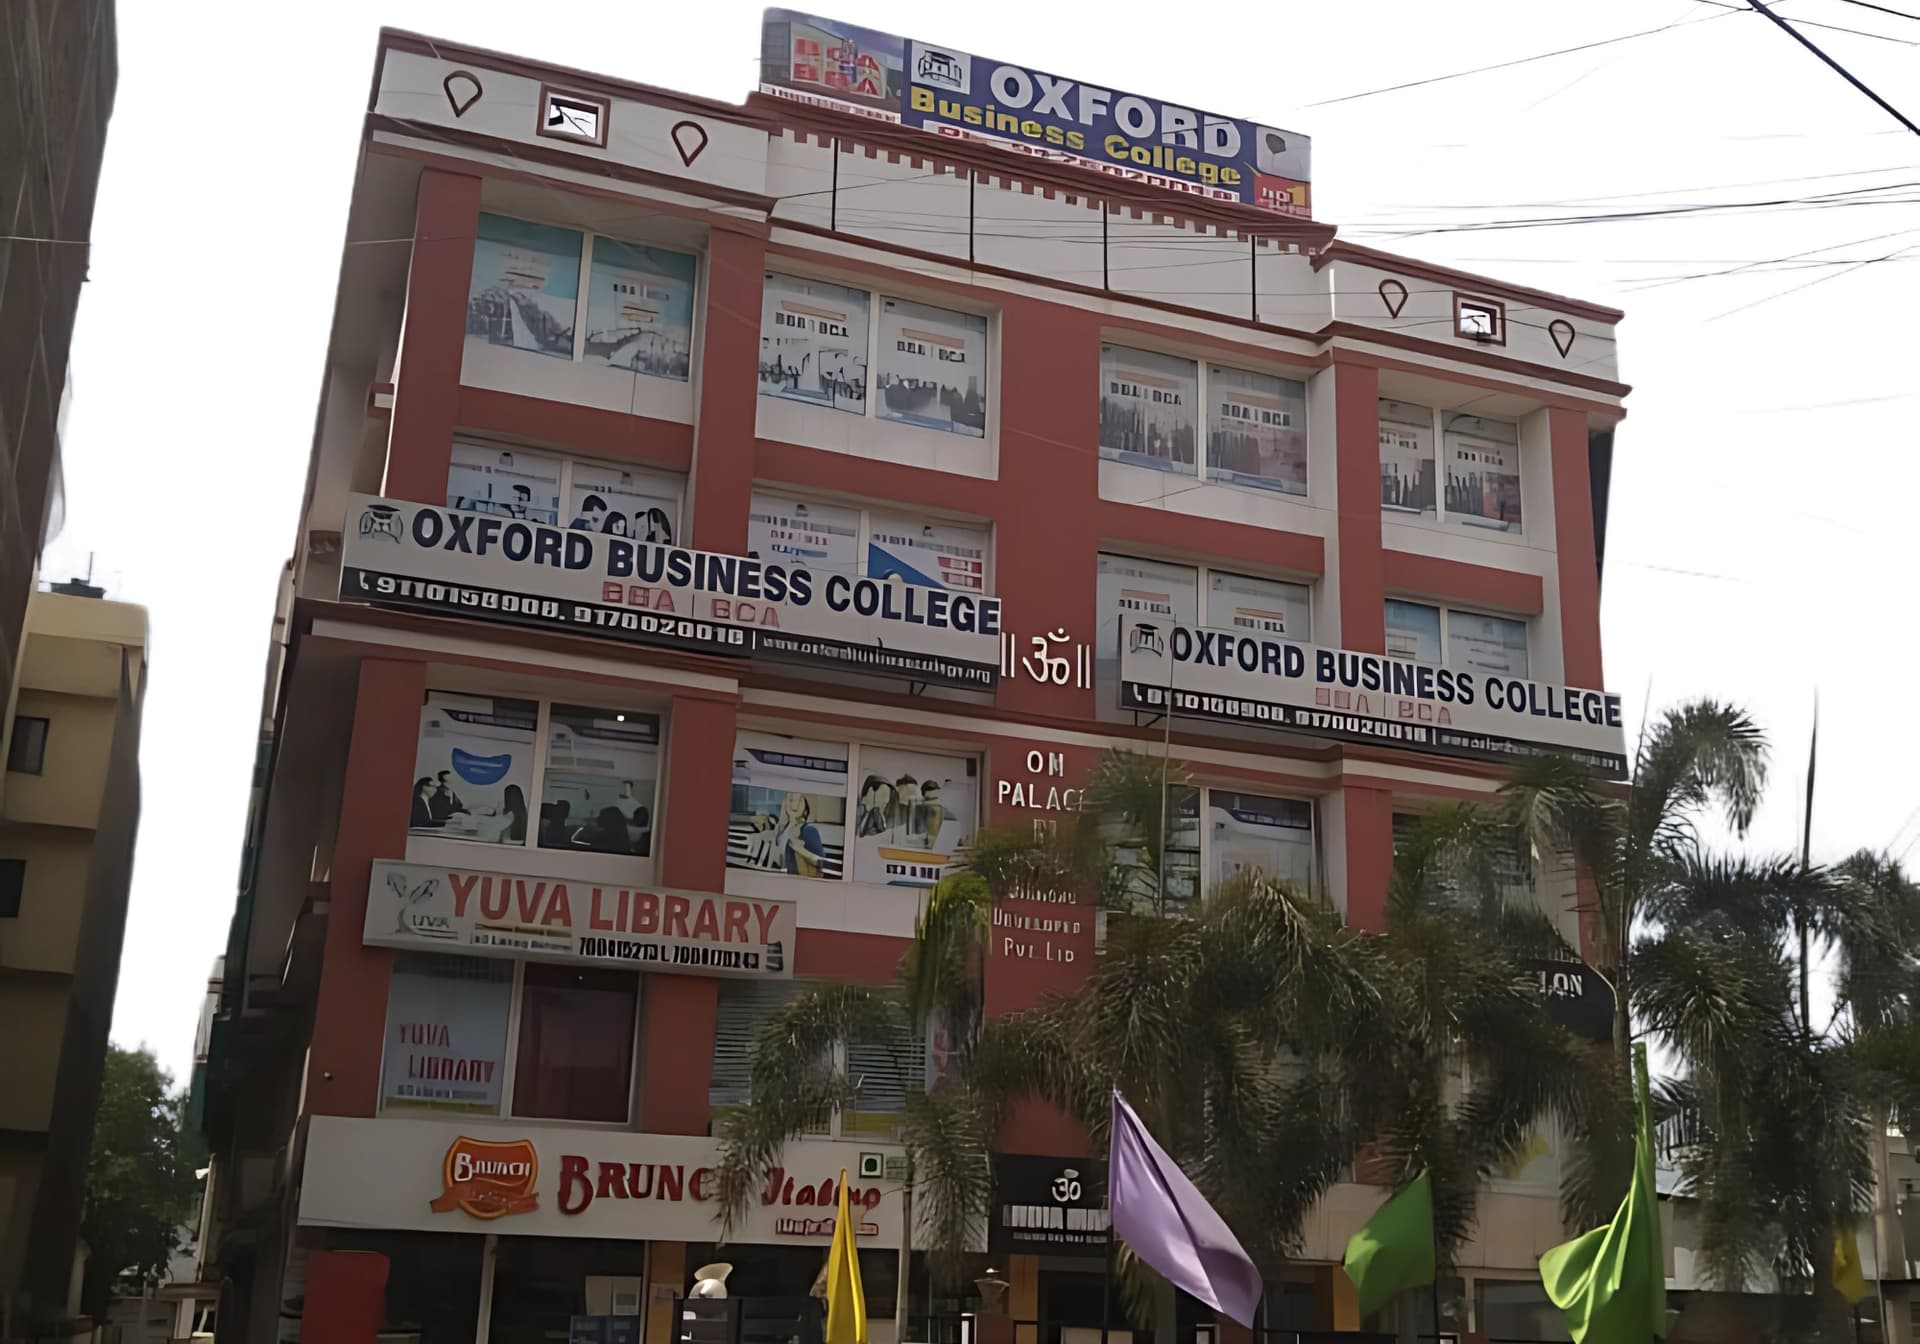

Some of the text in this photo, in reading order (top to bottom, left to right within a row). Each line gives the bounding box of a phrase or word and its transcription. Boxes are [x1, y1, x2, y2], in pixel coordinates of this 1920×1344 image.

[911, 86, 1086, 150] Business
[1104, 134, 1241, 186] College
[989, 65, 1242, 158] OXFORD
[412, 508, 593, 571] OXFORD
[607, 538, 812, 606] BUSINESS
[825, 574, 1000, 636] COLLEGE
[1171, 626, 1305, 679] OXFORD
[1316, 649, 1475, 706] BUSINESS
[1485, 677, 1623, 728] COLLEGE
[448, 873, 573, 927] YUVA
[588, 888, 781, 946] LIBRARY
